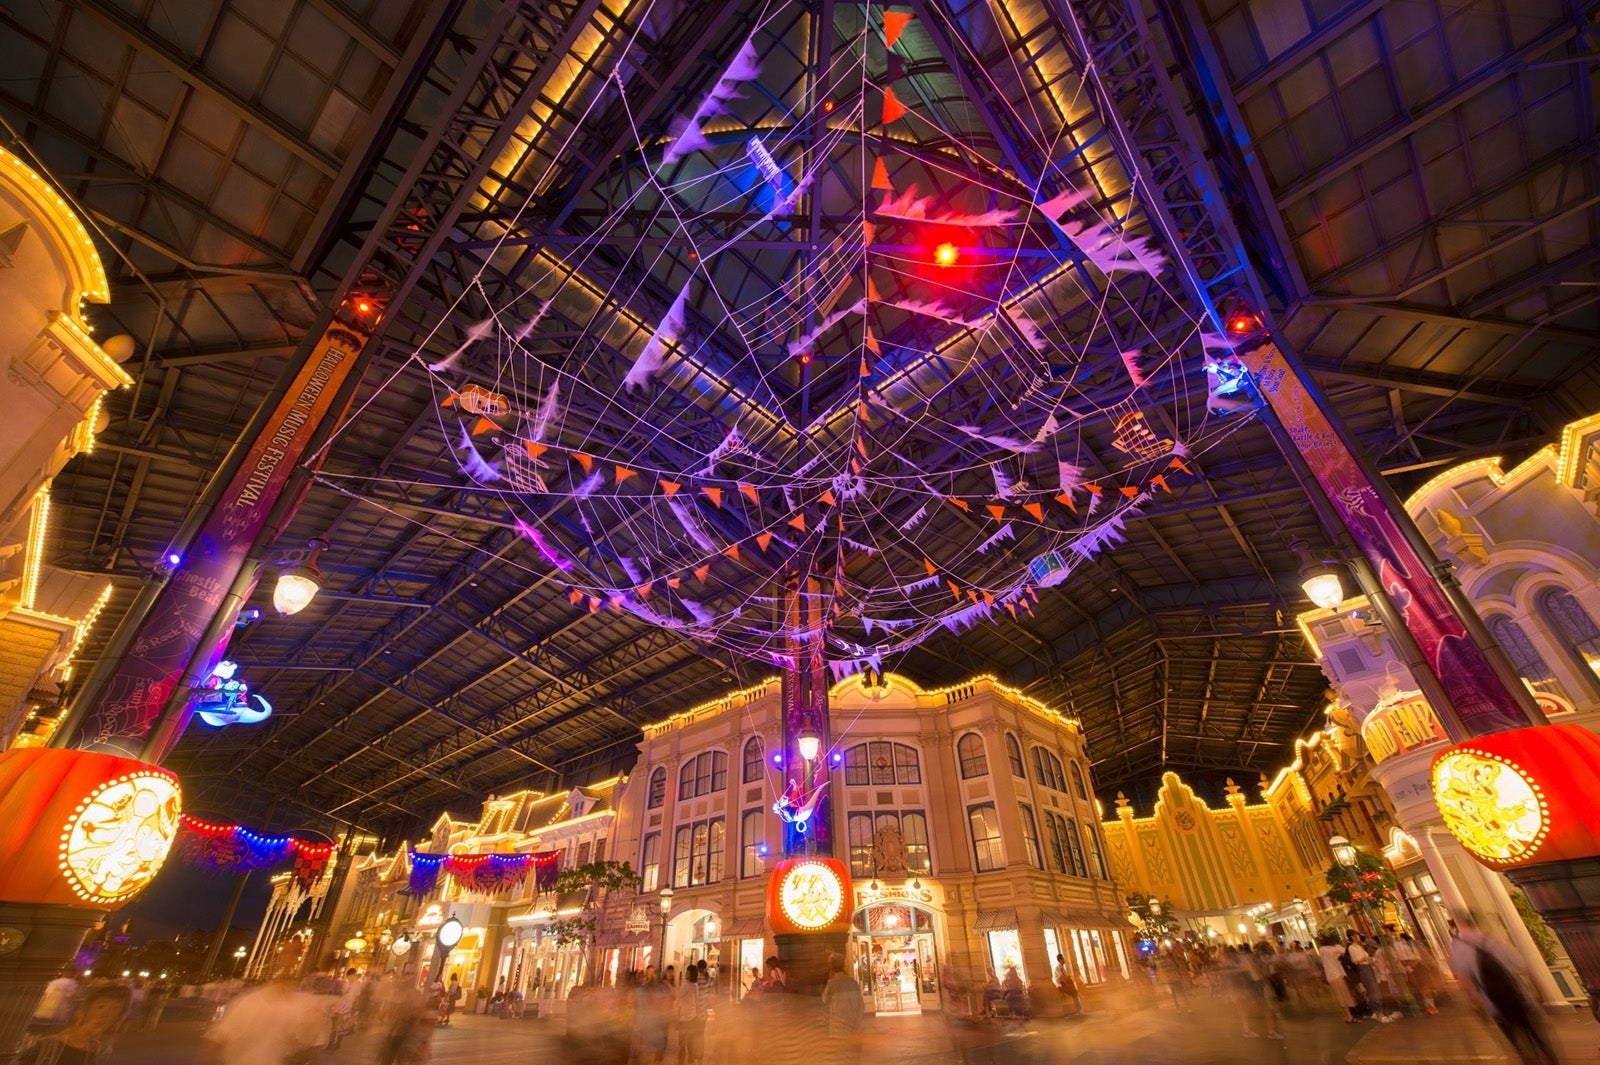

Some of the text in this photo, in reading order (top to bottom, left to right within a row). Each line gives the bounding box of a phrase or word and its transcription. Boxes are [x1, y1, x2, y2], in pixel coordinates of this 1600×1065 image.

[236, 347, 345, 507] HALLOWEEN MUSIC FESTIVAL
[173, 569, 221, 592] Ghostly
[150, 628, 181, 647] Rock
[857, 889, 933, 906] FASHIONS
